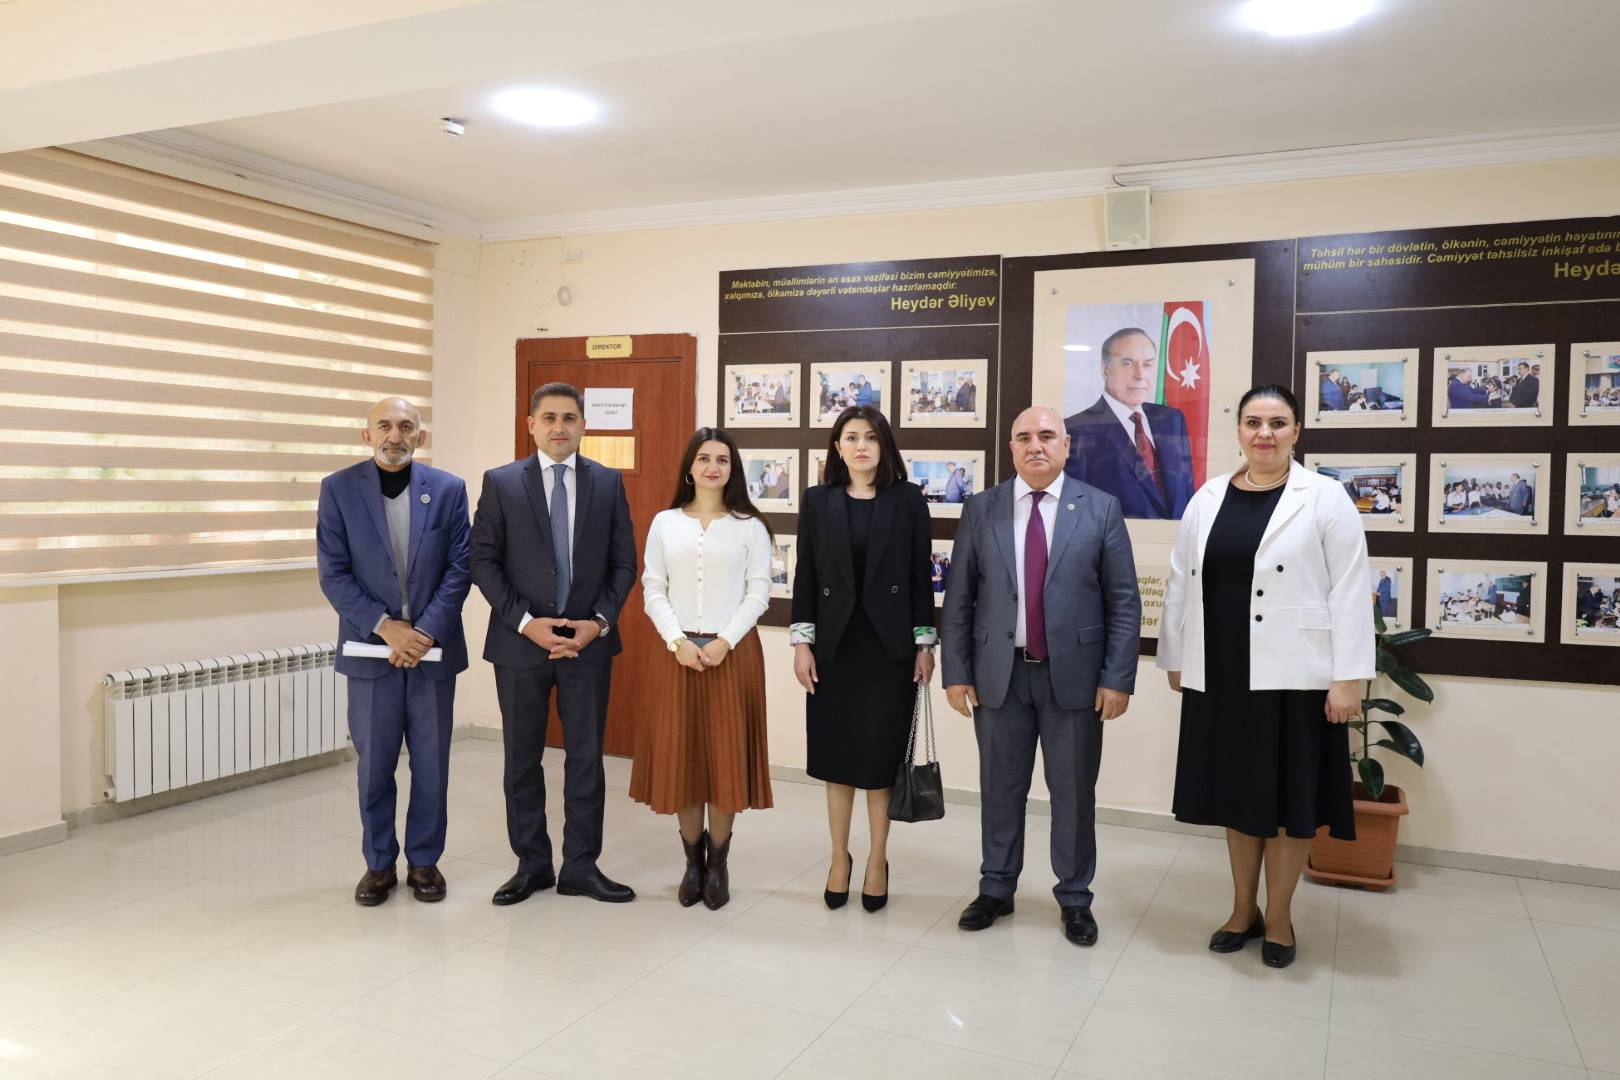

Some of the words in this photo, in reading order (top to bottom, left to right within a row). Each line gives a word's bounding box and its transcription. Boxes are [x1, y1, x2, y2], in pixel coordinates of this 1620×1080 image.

[1369, 245, 1383, 254] bir
[1387, 242, 1438, 253] dövlətin,
[1441, 239, 1489, 249] ölkənin,
[1493, 233, 1561, 246] cəmiyyətin
[1303, 260, 1345, 271] mühüm
[1349, 258, 1364, 268] bir
[1427, 250, 1484, 263] Cəmiyyət
[1487, 248, 1538, 260] təhsilsiz
[1542, 244, 1584, 257] inkişaf
[1588, 243, 1611, 254] edə
[900, 271, 925, 280] bizim
[806, 286, 836, 297] dəyərli
[891, 295, 944, 313] Heydər
[948, 293, 996, 311] Əliyev
